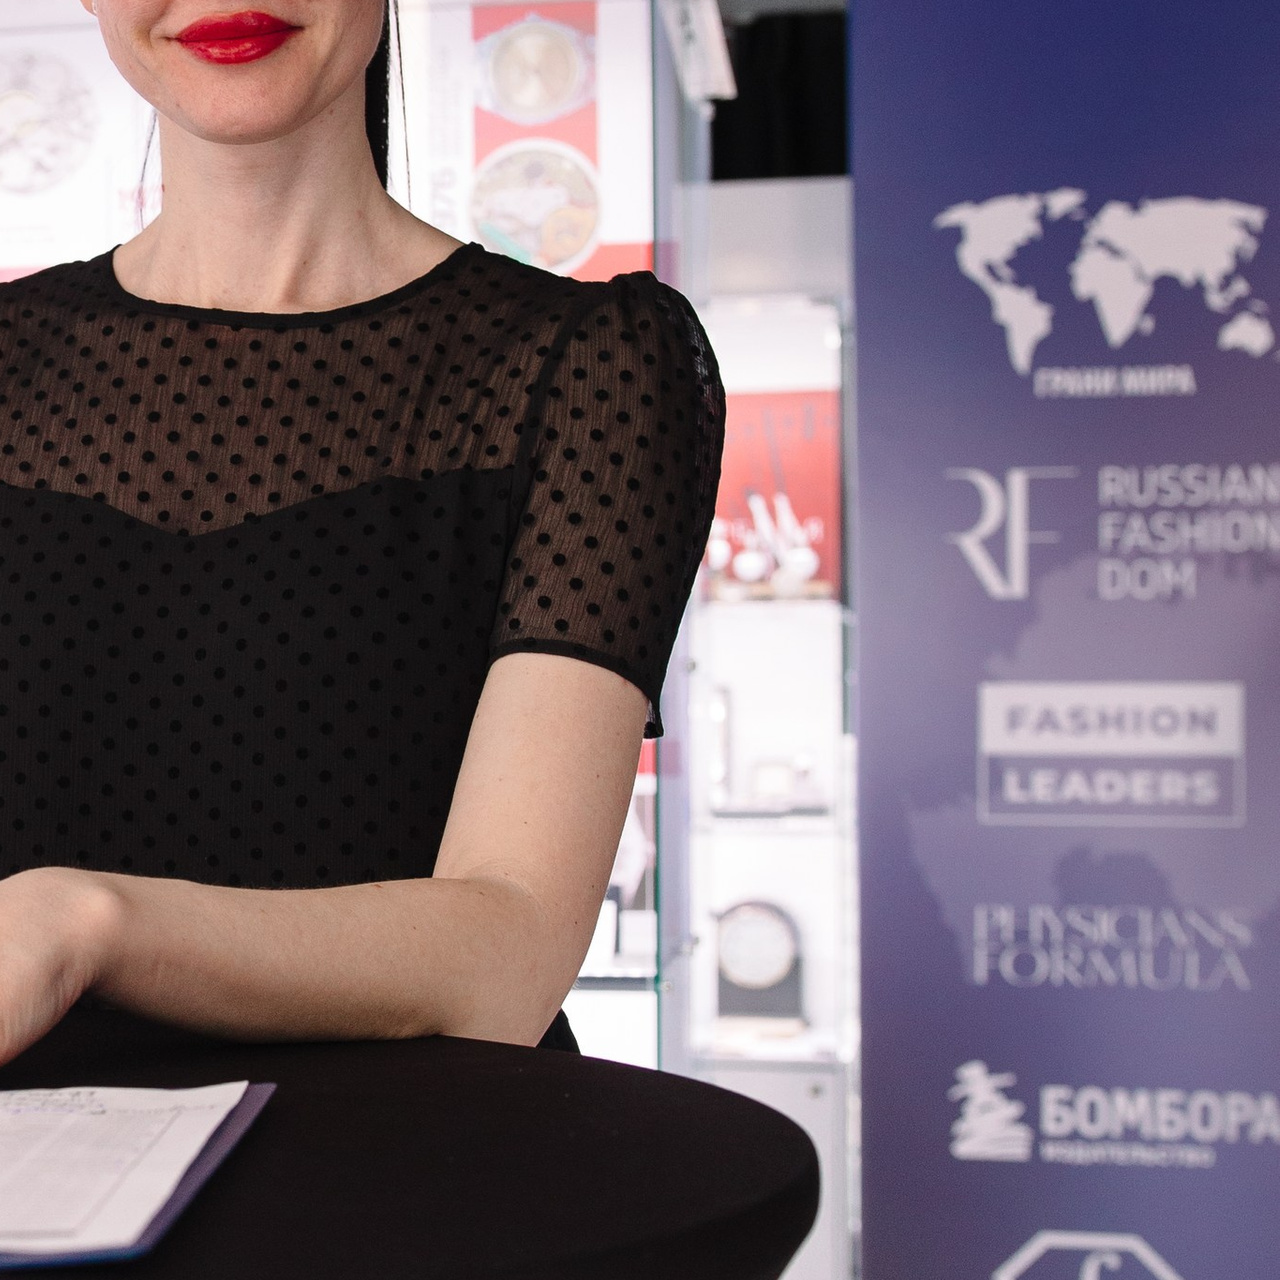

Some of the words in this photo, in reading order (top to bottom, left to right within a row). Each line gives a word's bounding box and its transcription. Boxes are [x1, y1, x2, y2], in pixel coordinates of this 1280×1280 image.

[1097, 464, 1280, 508] RUSSIAN
[1097, 509, 1280, 554] FASHION
[1096, 557, 1198, 601] DOM
[1004, 704, 1220, 739] FASHION
[1001, 766, 1221, 806] LEADERS
[972, 904, 1254, 947] PHYSICIANS
[971, 944, 1253, 991] FORMULA
[1041, 1084, 1280, 1143] БОМБОРА
